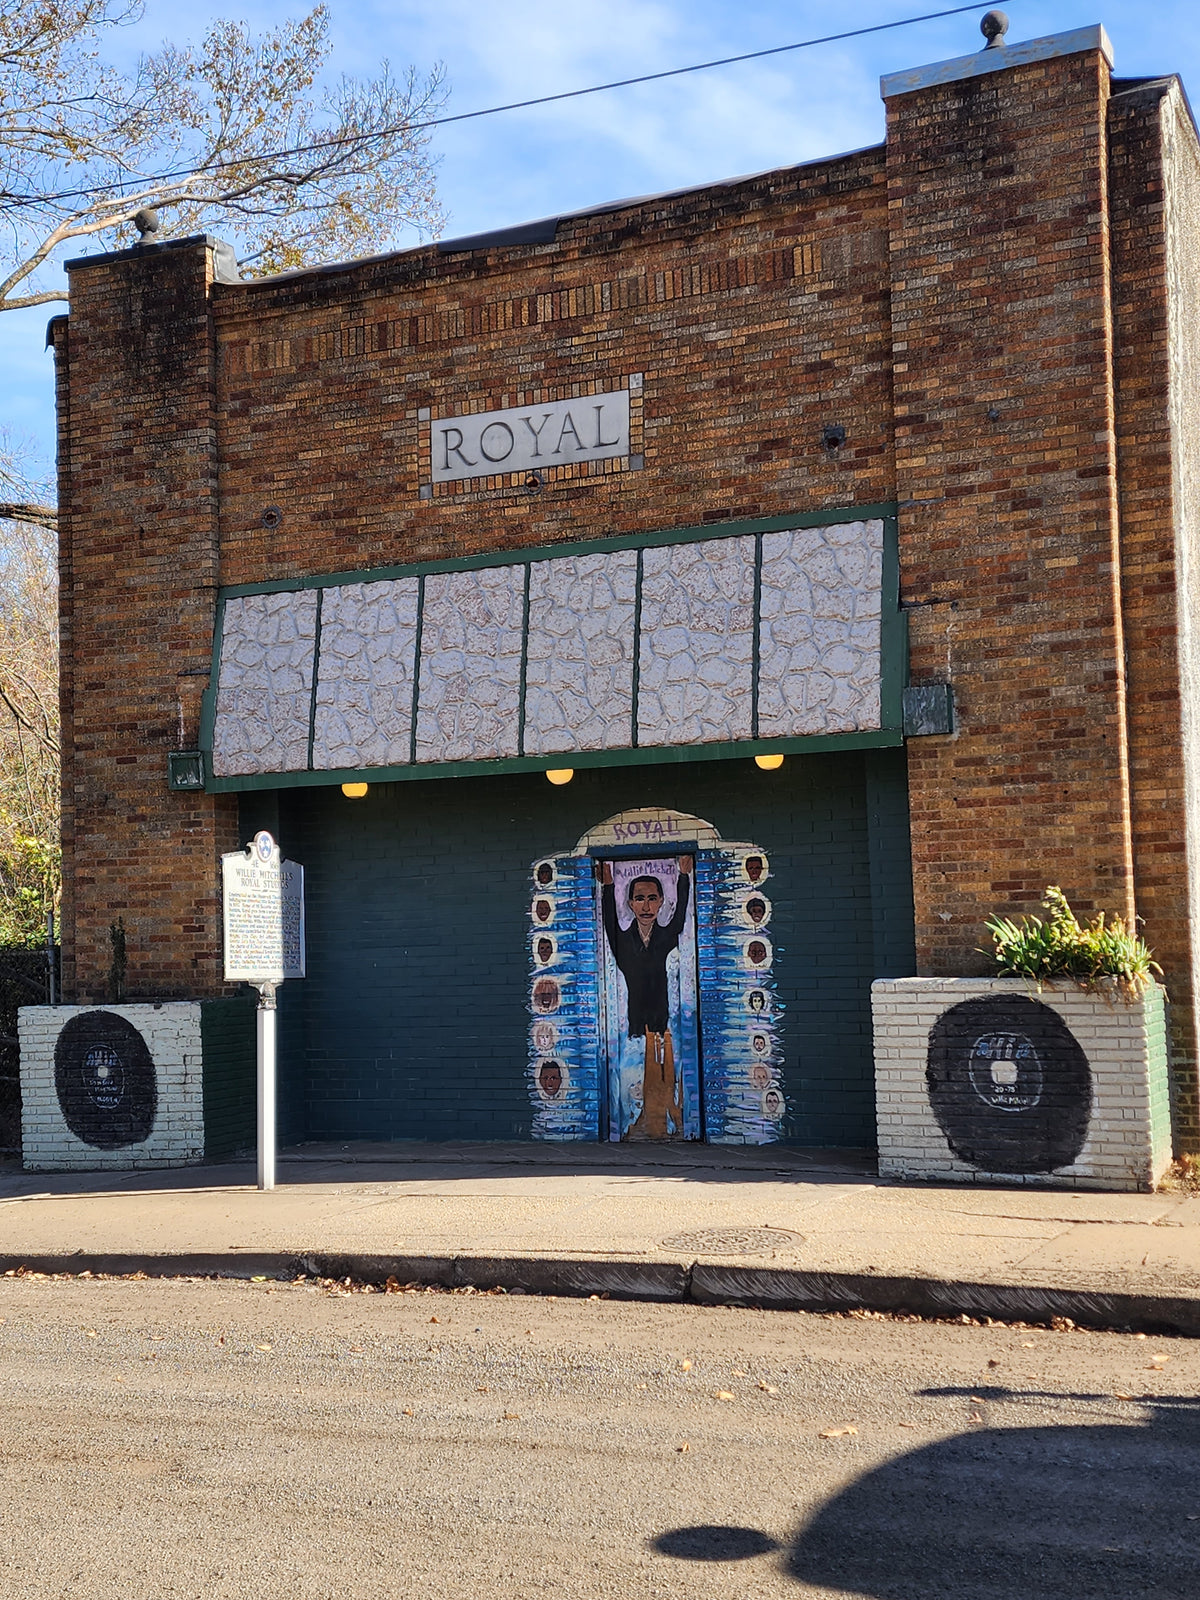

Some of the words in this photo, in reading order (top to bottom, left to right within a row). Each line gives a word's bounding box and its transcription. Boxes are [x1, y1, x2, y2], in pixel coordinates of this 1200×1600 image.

[440, 404, 620, 471] ROYAL
[613, 815, 681, 840] ROYAL
[236, 868, 256, 878] WILLIE
[241, 878, 260, 888] ROYAL
